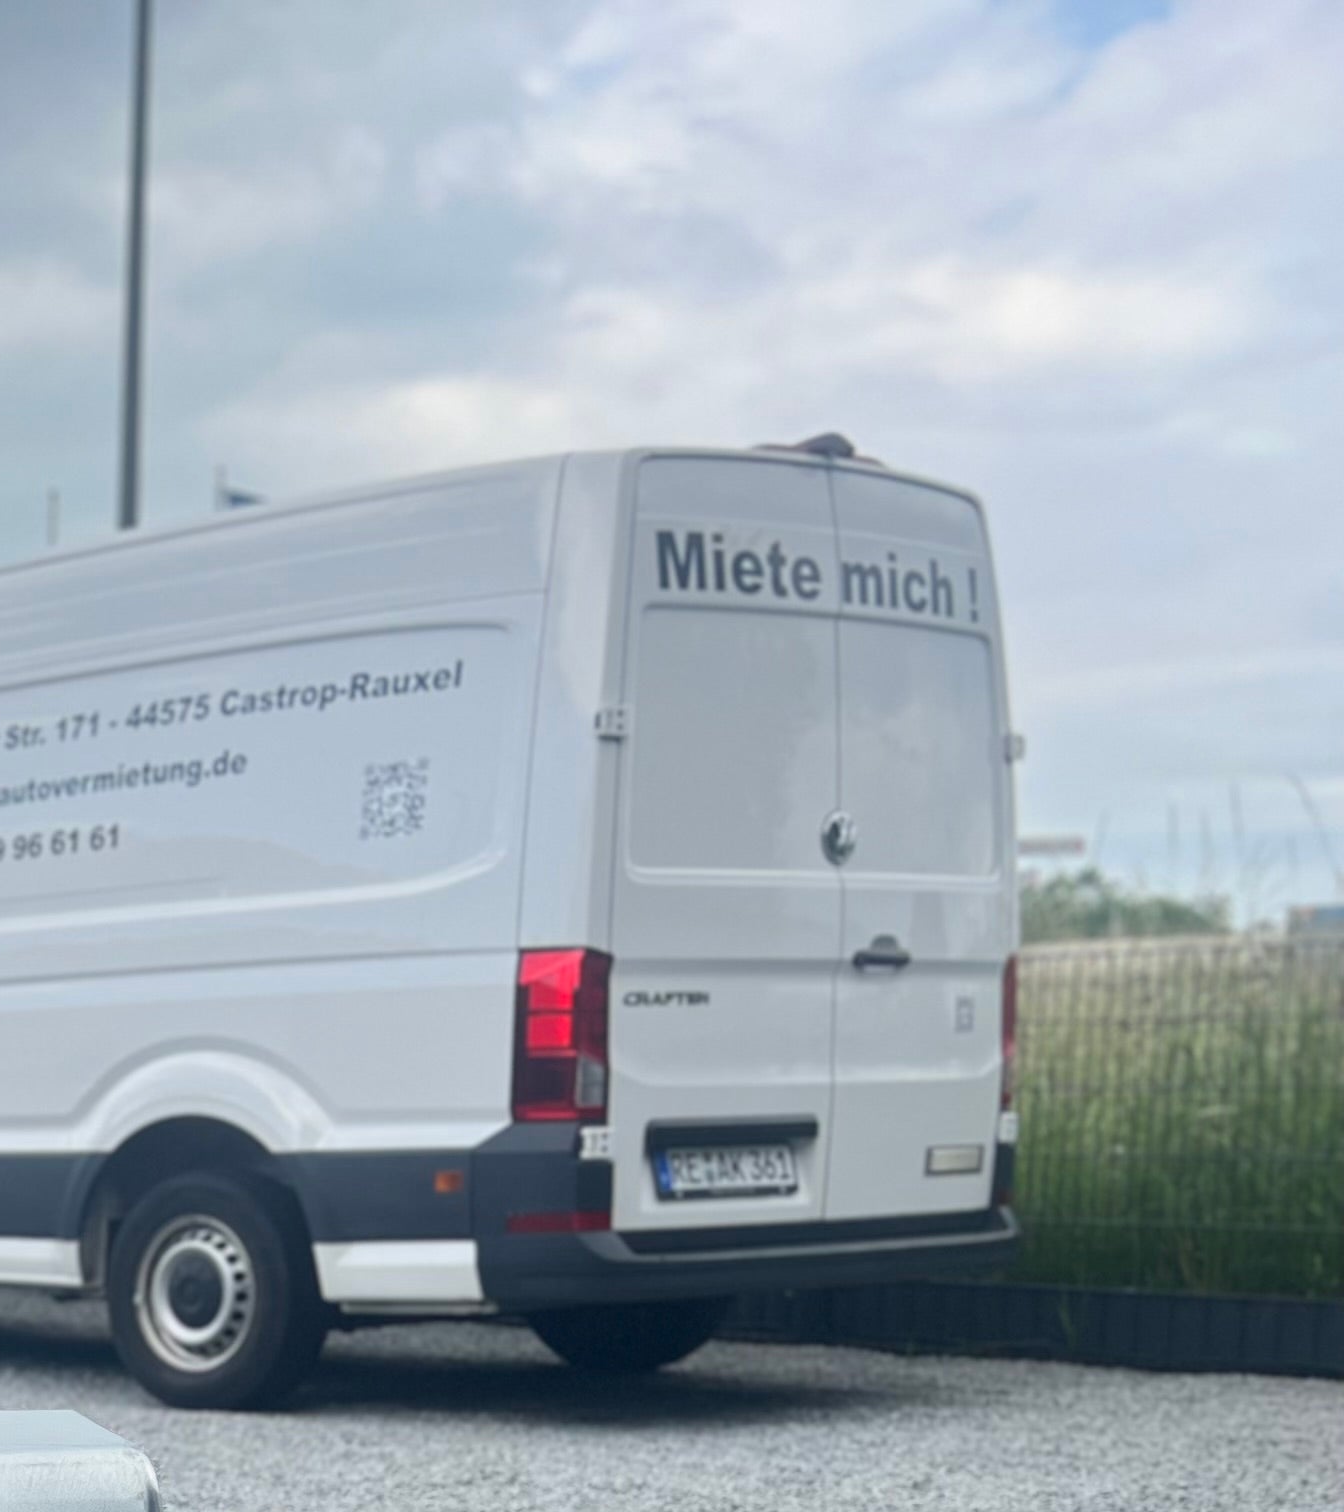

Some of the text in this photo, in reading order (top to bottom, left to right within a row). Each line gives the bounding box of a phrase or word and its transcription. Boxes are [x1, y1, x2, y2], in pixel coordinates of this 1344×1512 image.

[656, 530, 979, 622] Miete mich !
[4, 723, 46, 751] Str.
[56, 712, 100, 742] 171
[125, 694, 210, 729] 44575
[220, 659, 464, 717] Castrop-Rauxel
[13, 833, 42, 860] 96
[50, 829, 79, 856] 61
[89, 823, 119, 851] 61
[670, 1149, 790, 1184] RE AK 361
